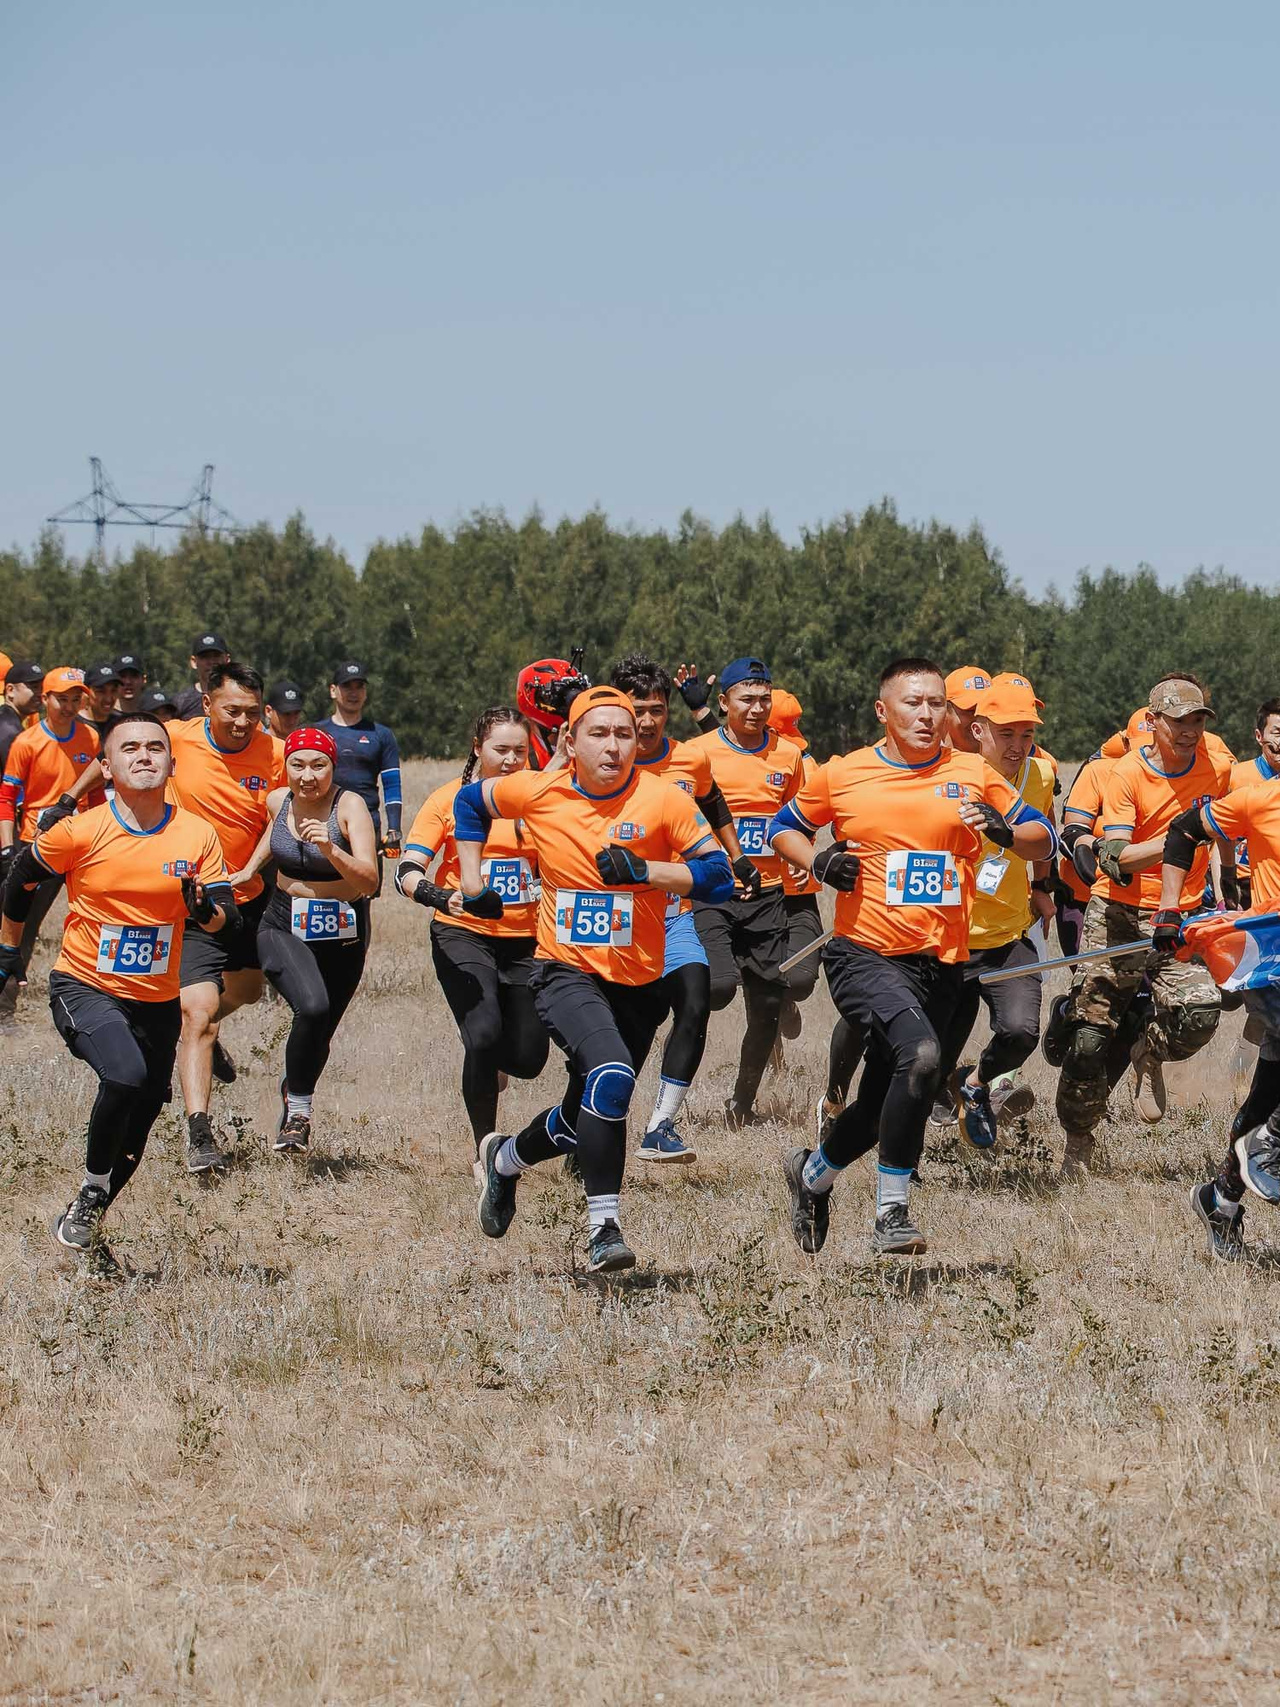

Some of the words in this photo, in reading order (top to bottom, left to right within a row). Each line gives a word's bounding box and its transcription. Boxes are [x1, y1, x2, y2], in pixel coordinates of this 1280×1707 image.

[739, 830, 763, 849] 45
[496, 865, 506, 873] BI
[913, 858, 925, 867] BI
[492, 875, 519, 897] 58
[908, 871, 942, 896] 58
[581, 898, 593, 907] BI
[310, 914, 339, 934] 58
[576, 910, 610, 936] 58
[128, 930, 139, 939] BI
[120, 942, 153, 966] 58
